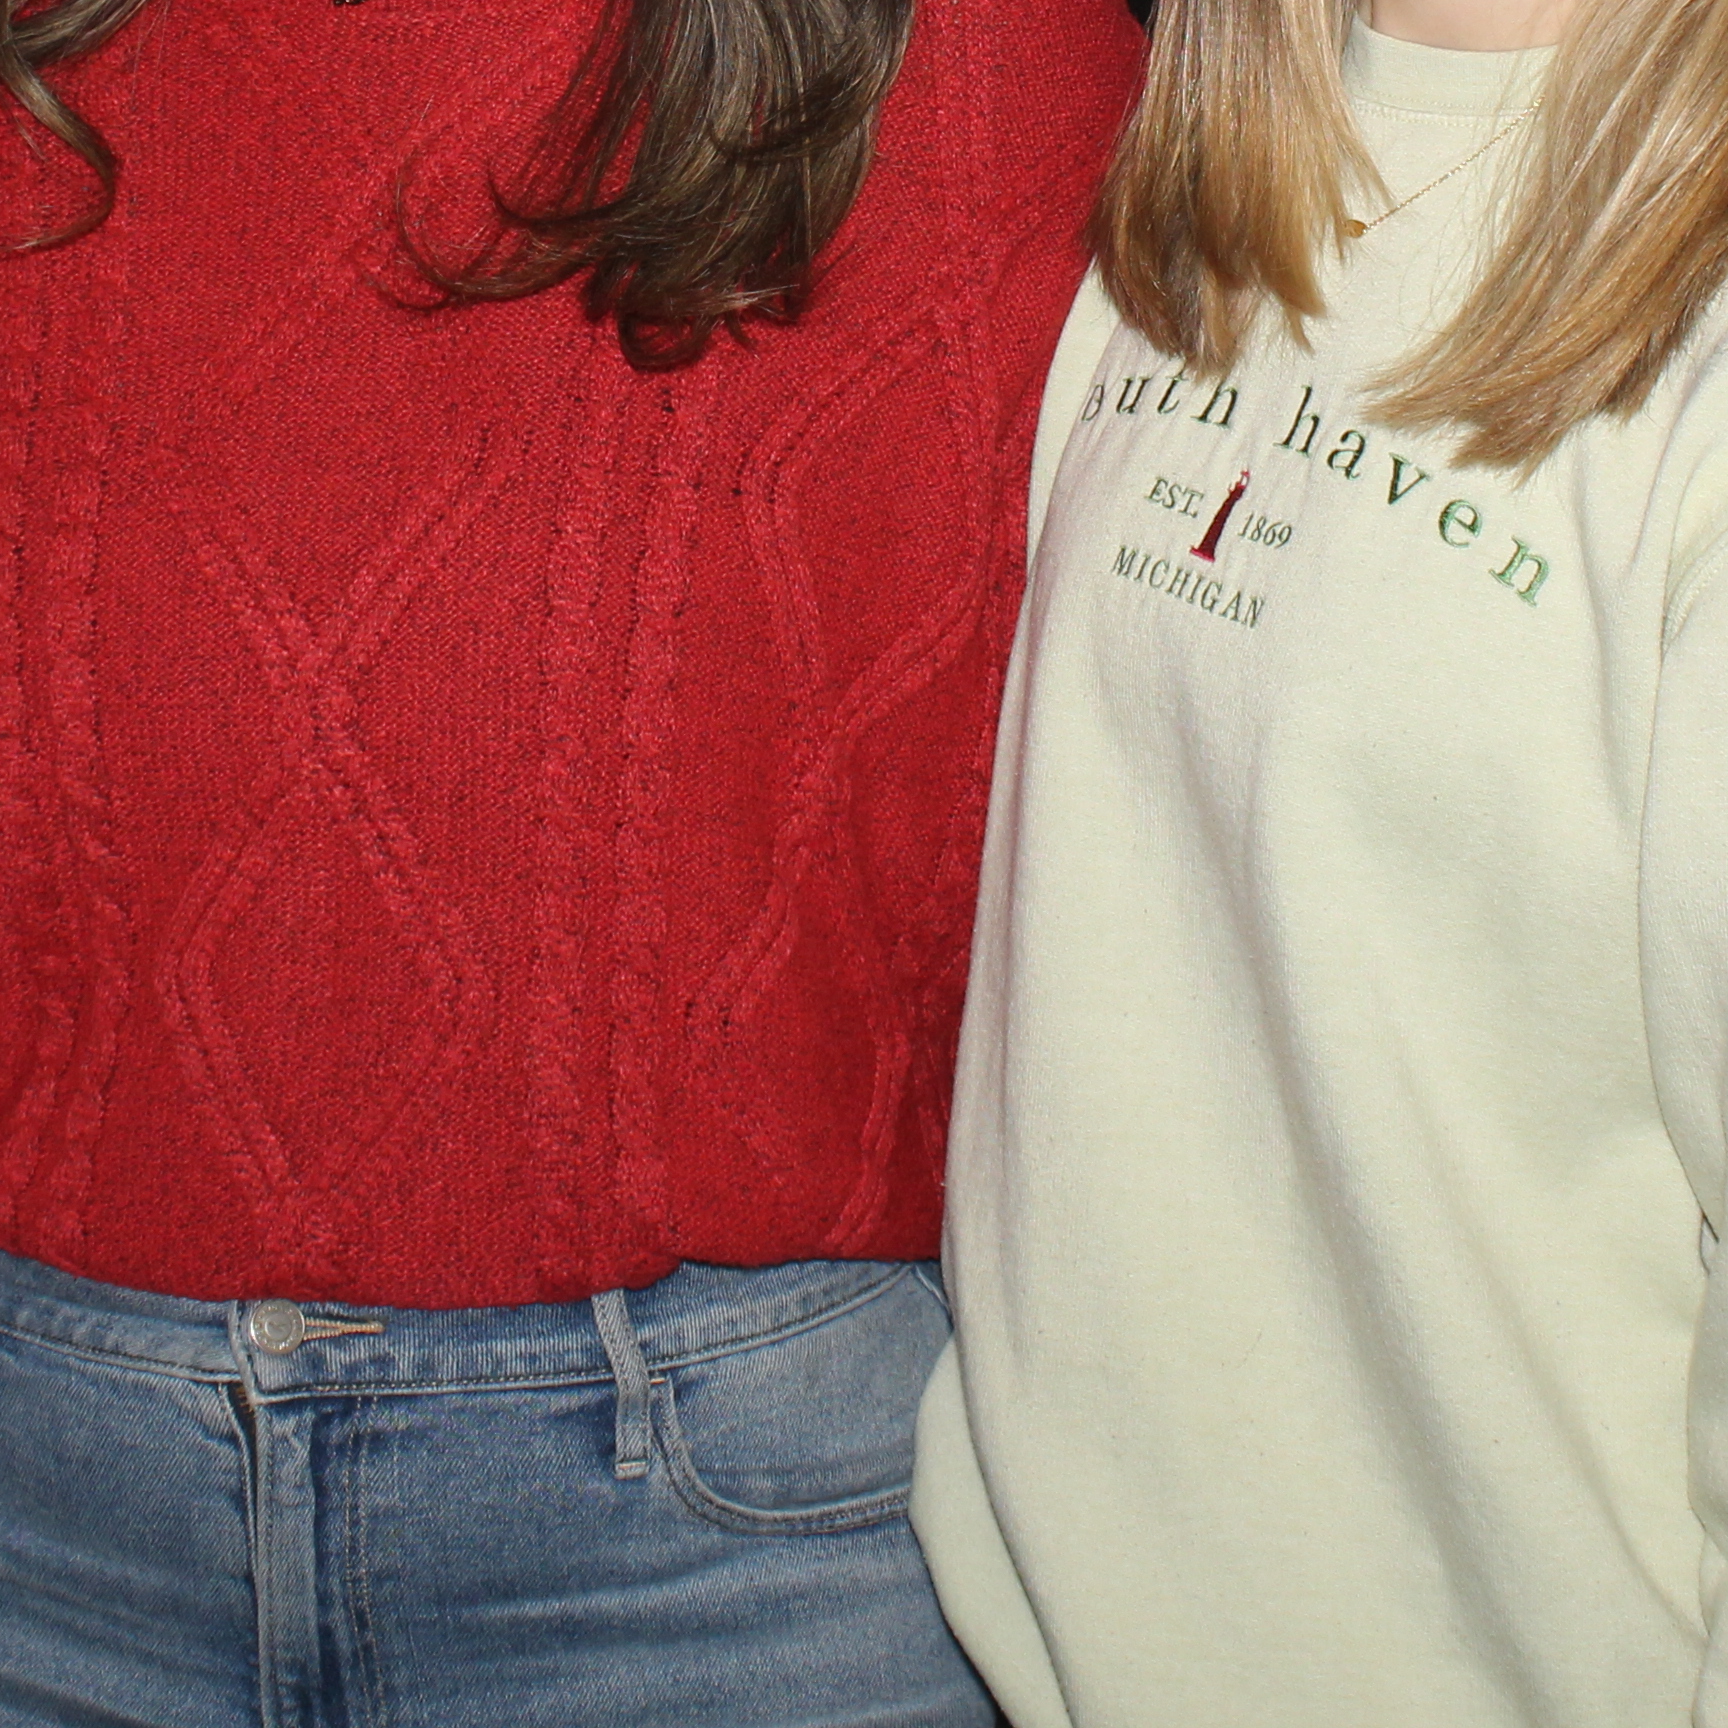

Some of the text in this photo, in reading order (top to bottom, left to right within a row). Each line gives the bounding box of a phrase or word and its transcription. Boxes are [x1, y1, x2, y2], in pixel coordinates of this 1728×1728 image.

[1081, 359, 1552, 608] outh haven
[1144, 476, 1293, 550] EST. 1869
[1110, 544, 1265, 629] MICHIGAN
